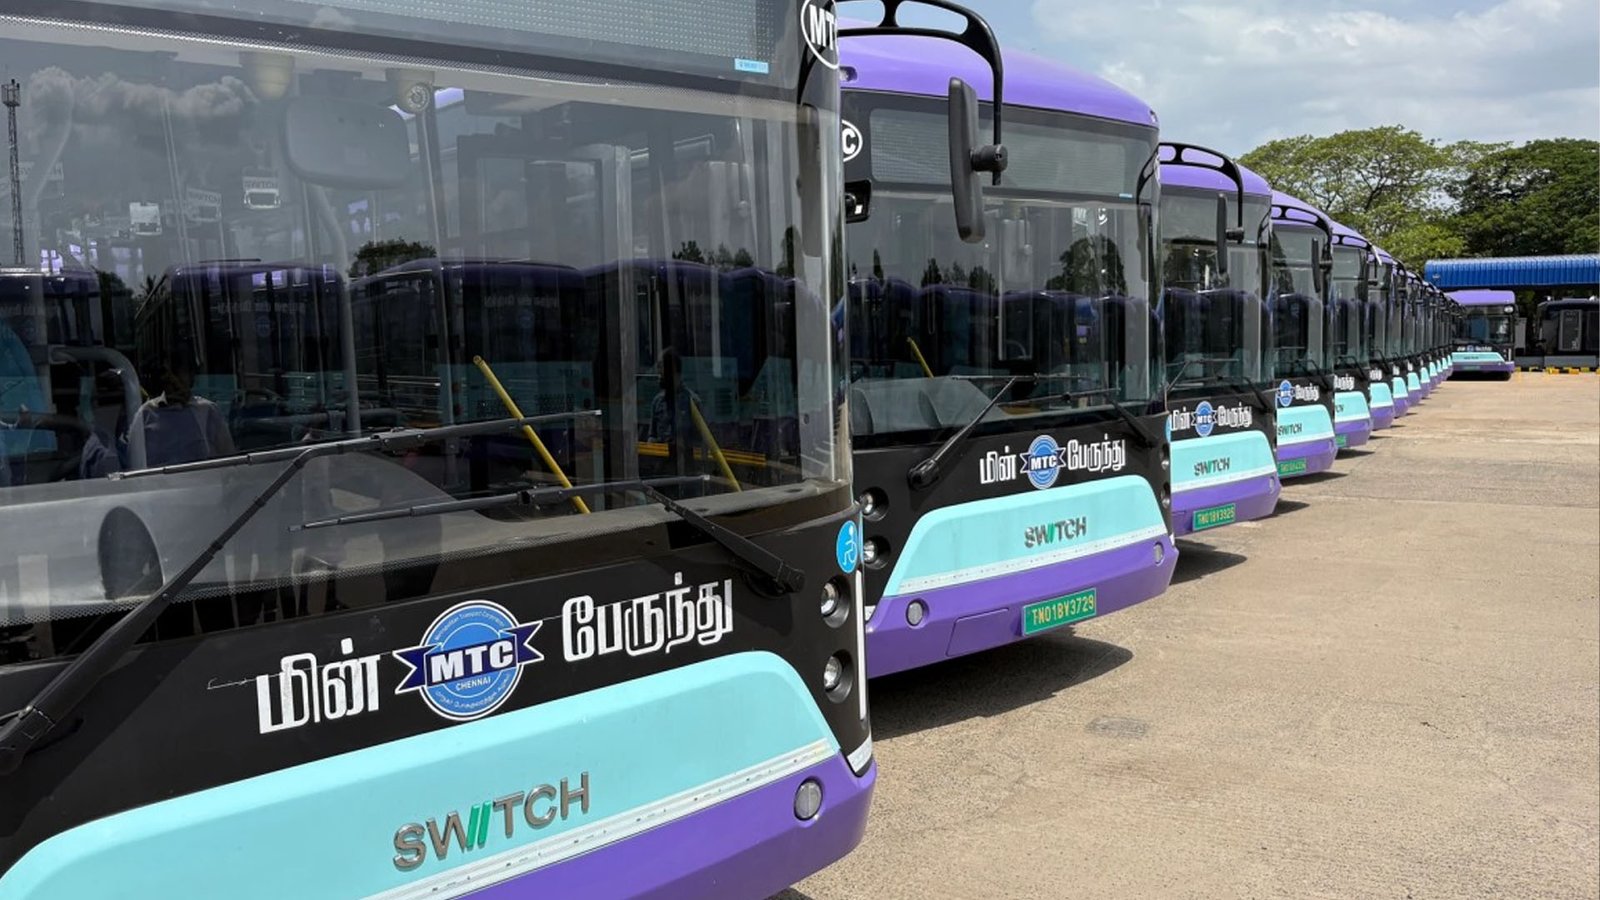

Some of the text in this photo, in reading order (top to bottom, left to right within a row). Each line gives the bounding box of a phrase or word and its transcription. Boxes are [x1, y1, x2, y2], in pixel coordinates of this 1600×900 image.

[809, 4, 837, 50] MT
[979, 433, 1127, 485] மின் பேருந்து
[1030, 455, 1058, 471] MTC
[1024, 517, 1087, 549] SWITCH
[1032, 596, 1096, 627] TN01BV3729
[257, 571, 733, 735] மின் பேருந்து
[431, 641, 514, 683] MTC
[455, 676, 492, 691] CHENNAI
[392, 771, 590, 870] SWITCH
